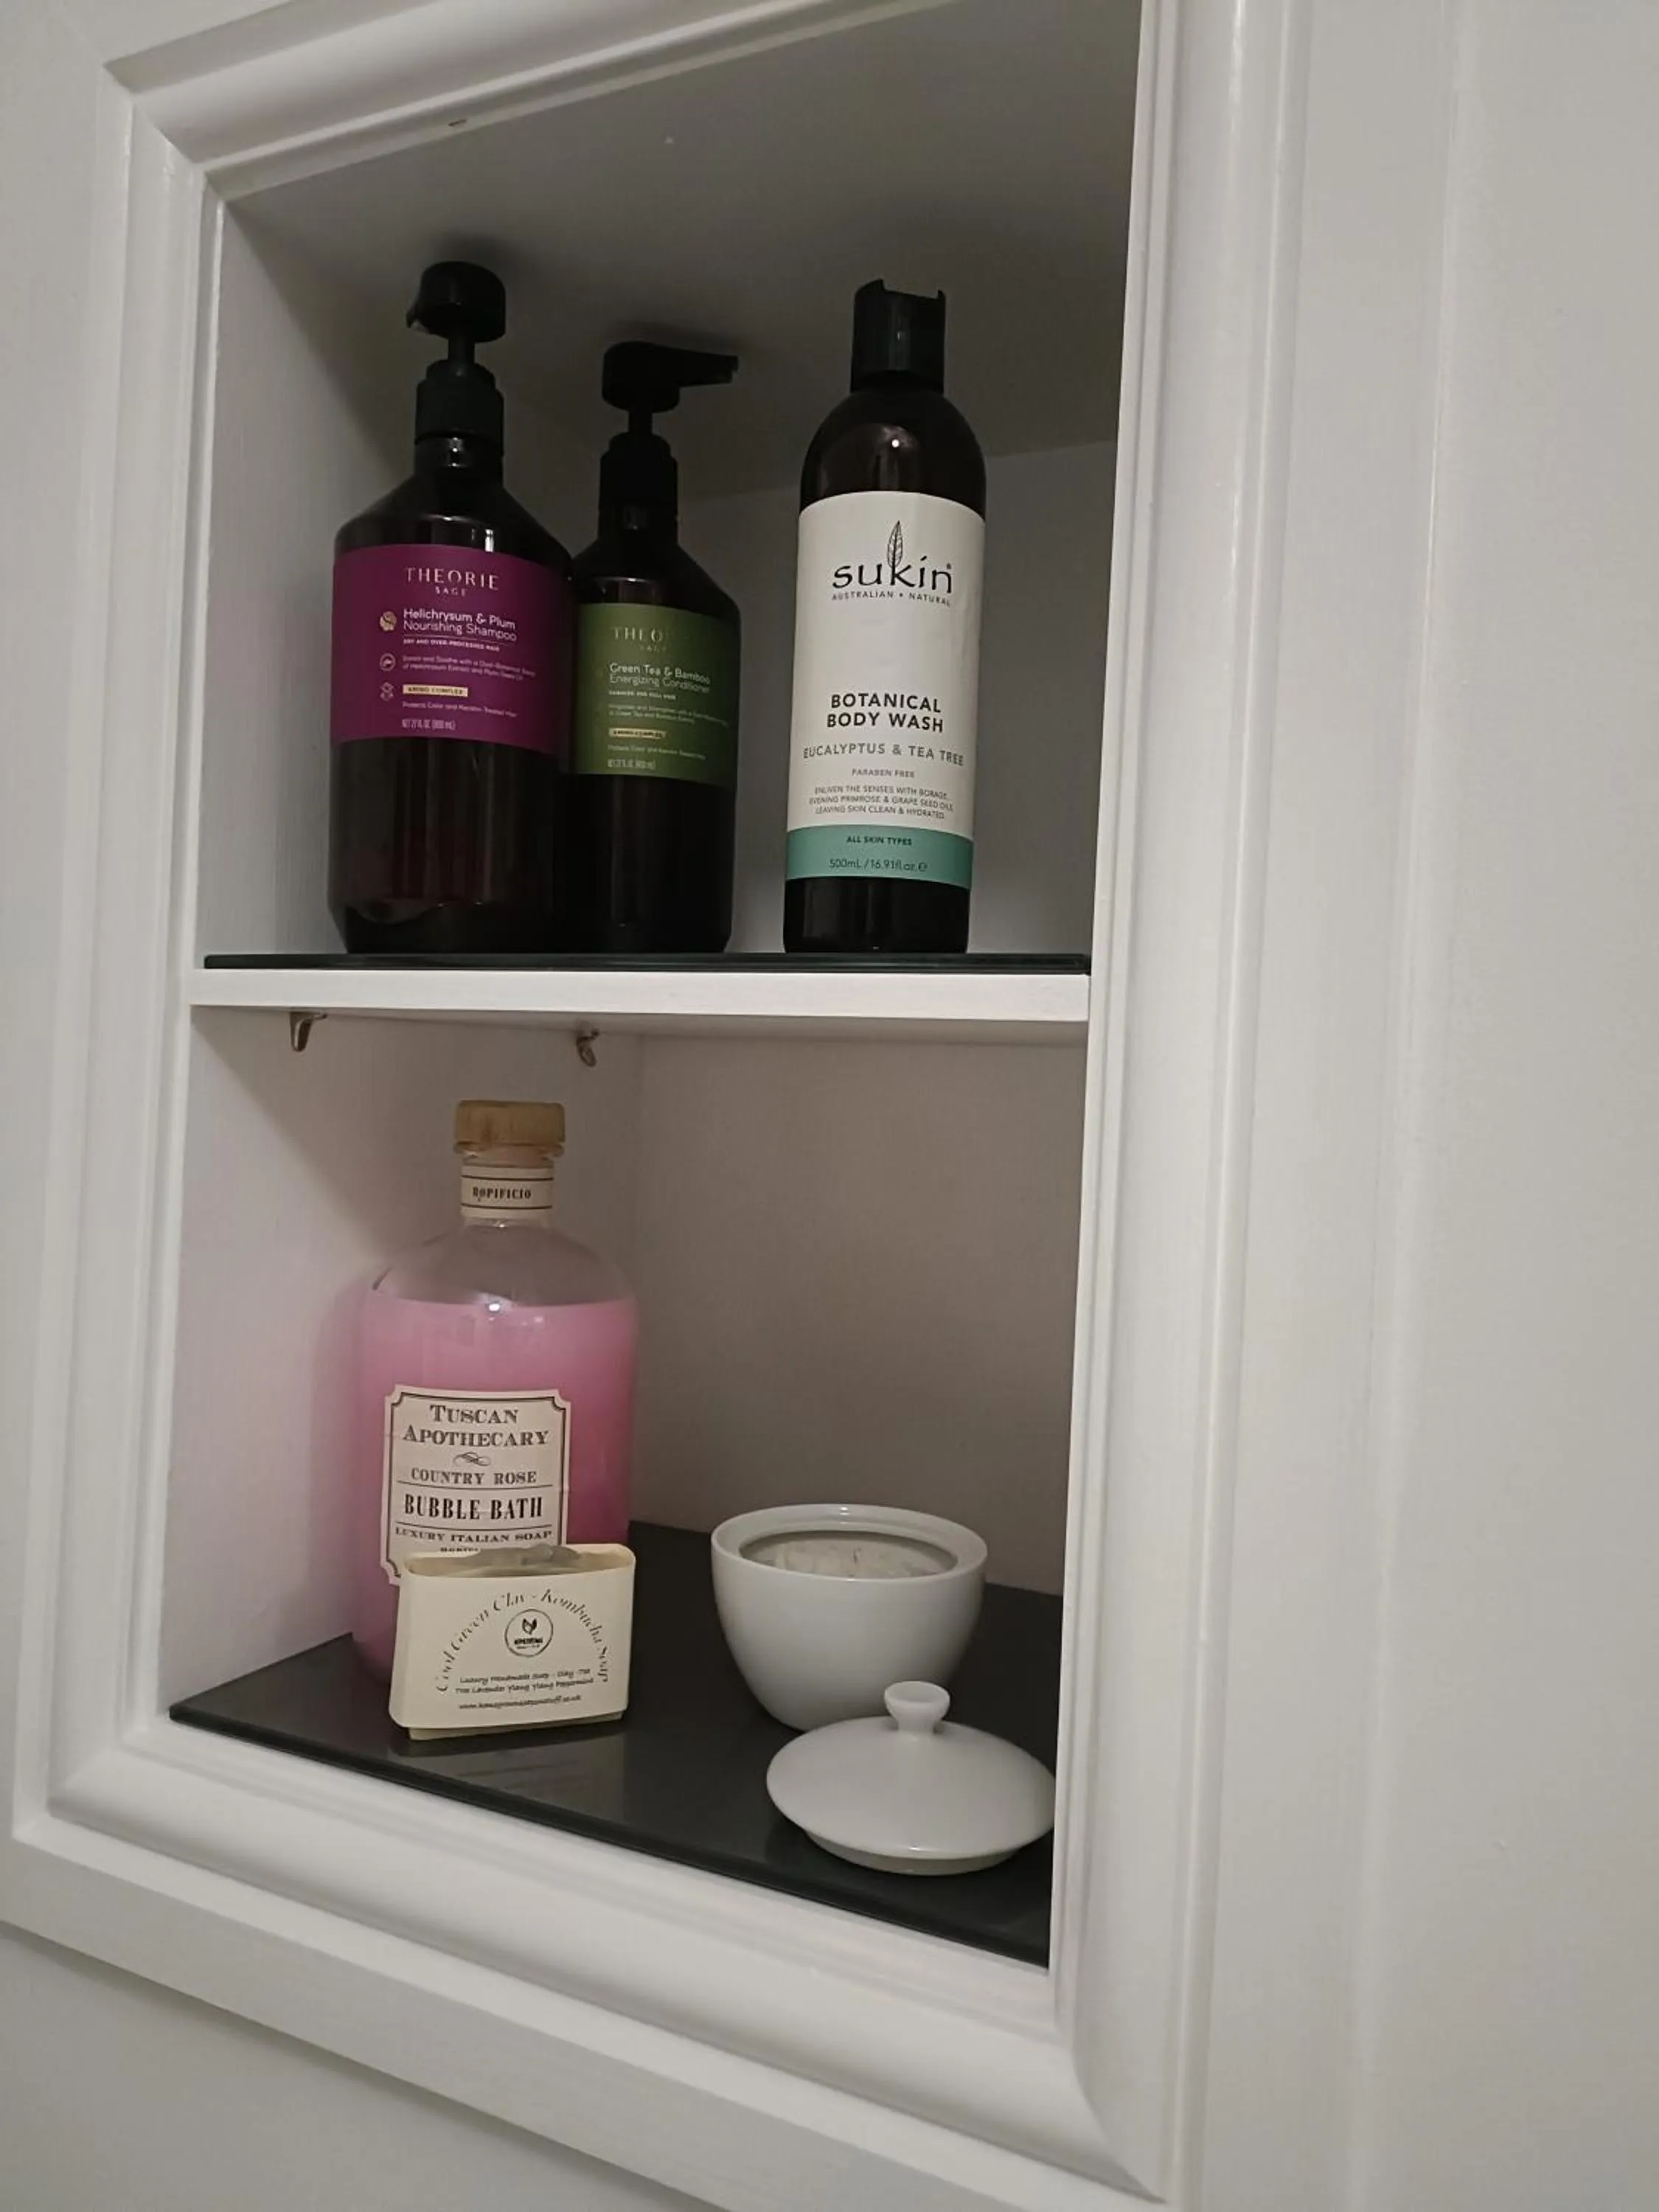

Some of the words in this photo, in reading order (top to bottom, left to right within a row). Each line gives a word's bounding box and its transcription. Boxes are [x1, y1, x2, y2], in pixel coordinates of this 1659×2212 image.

[406, 567, 499, 590] THEORIE
[832, 549, 952, 594] sukin
[435, 586, 466, 596] SAGE
[831, 591, 894, 601] AUSTRALIAN
[908, 593, 950, 607] NATURAL
[403, 609, 473, 623] Helichrysum
[476, 613, 487, 624] &
[490, 614, 516, 629] Plum
[403, 620, 462, 636] Nourishing
[467, 624, 517, 641] Shampoo
[609, 663, 640, 673] Green
[644, 665, 660, 675] Tea
[664, 667, 672, 676] &
[675, 668, 710, 685] Bamboo
[610, 674, 659, 688] Energizing
[830, 693, 941, 713] BOTANICAL
[827, 712, 880, 728] BODY
[888, 713, 944, 734] WASH
[803, 742, 885, 759] EUCALYPTUS
[892, 744, 902, 755] &
[908, 745, 935, 759] TEA
[939, 750, 964, 766] TREE
[852, 768, 891, 777] PARABEN
[894, 770, 915, 778] FREE
[815, 785, 844, 795] ENLIVEN
[863, 785, 894, 793] SENSES
[896, 787, 917, 795] WITH
[809, 796, 838, 804] EVENING
[891, 796, 918, 805] GRAPE
[920, 799, 939, 808] SEED
[815, 806, 846, 815] LEAVING
[848, 806, 866, 814] SKIN
[868, 806, 896, 815] CLEAN
[864, 836, 884, 844] SKIN
[887, 837, 912, 846] TYPES
[829, 858, 863, 869] 500mL
[431, 1404, 518, 1424] TUSCAN
[403, 1425, 549, 1447] APOTHECARY
[411, 1468, 484, 1484] COUNTRY
[494, 1471, 537, 1484] ROSE
[405, 1494, 480, 1520] BUBBLE
[490, 1497, 542, 1520] BATH
[396, 1527, 445, 1541] LUXURY
[450, 1534, 509, 1543] ITALIAN
[515, 1531, 552, 1541] SOAP
